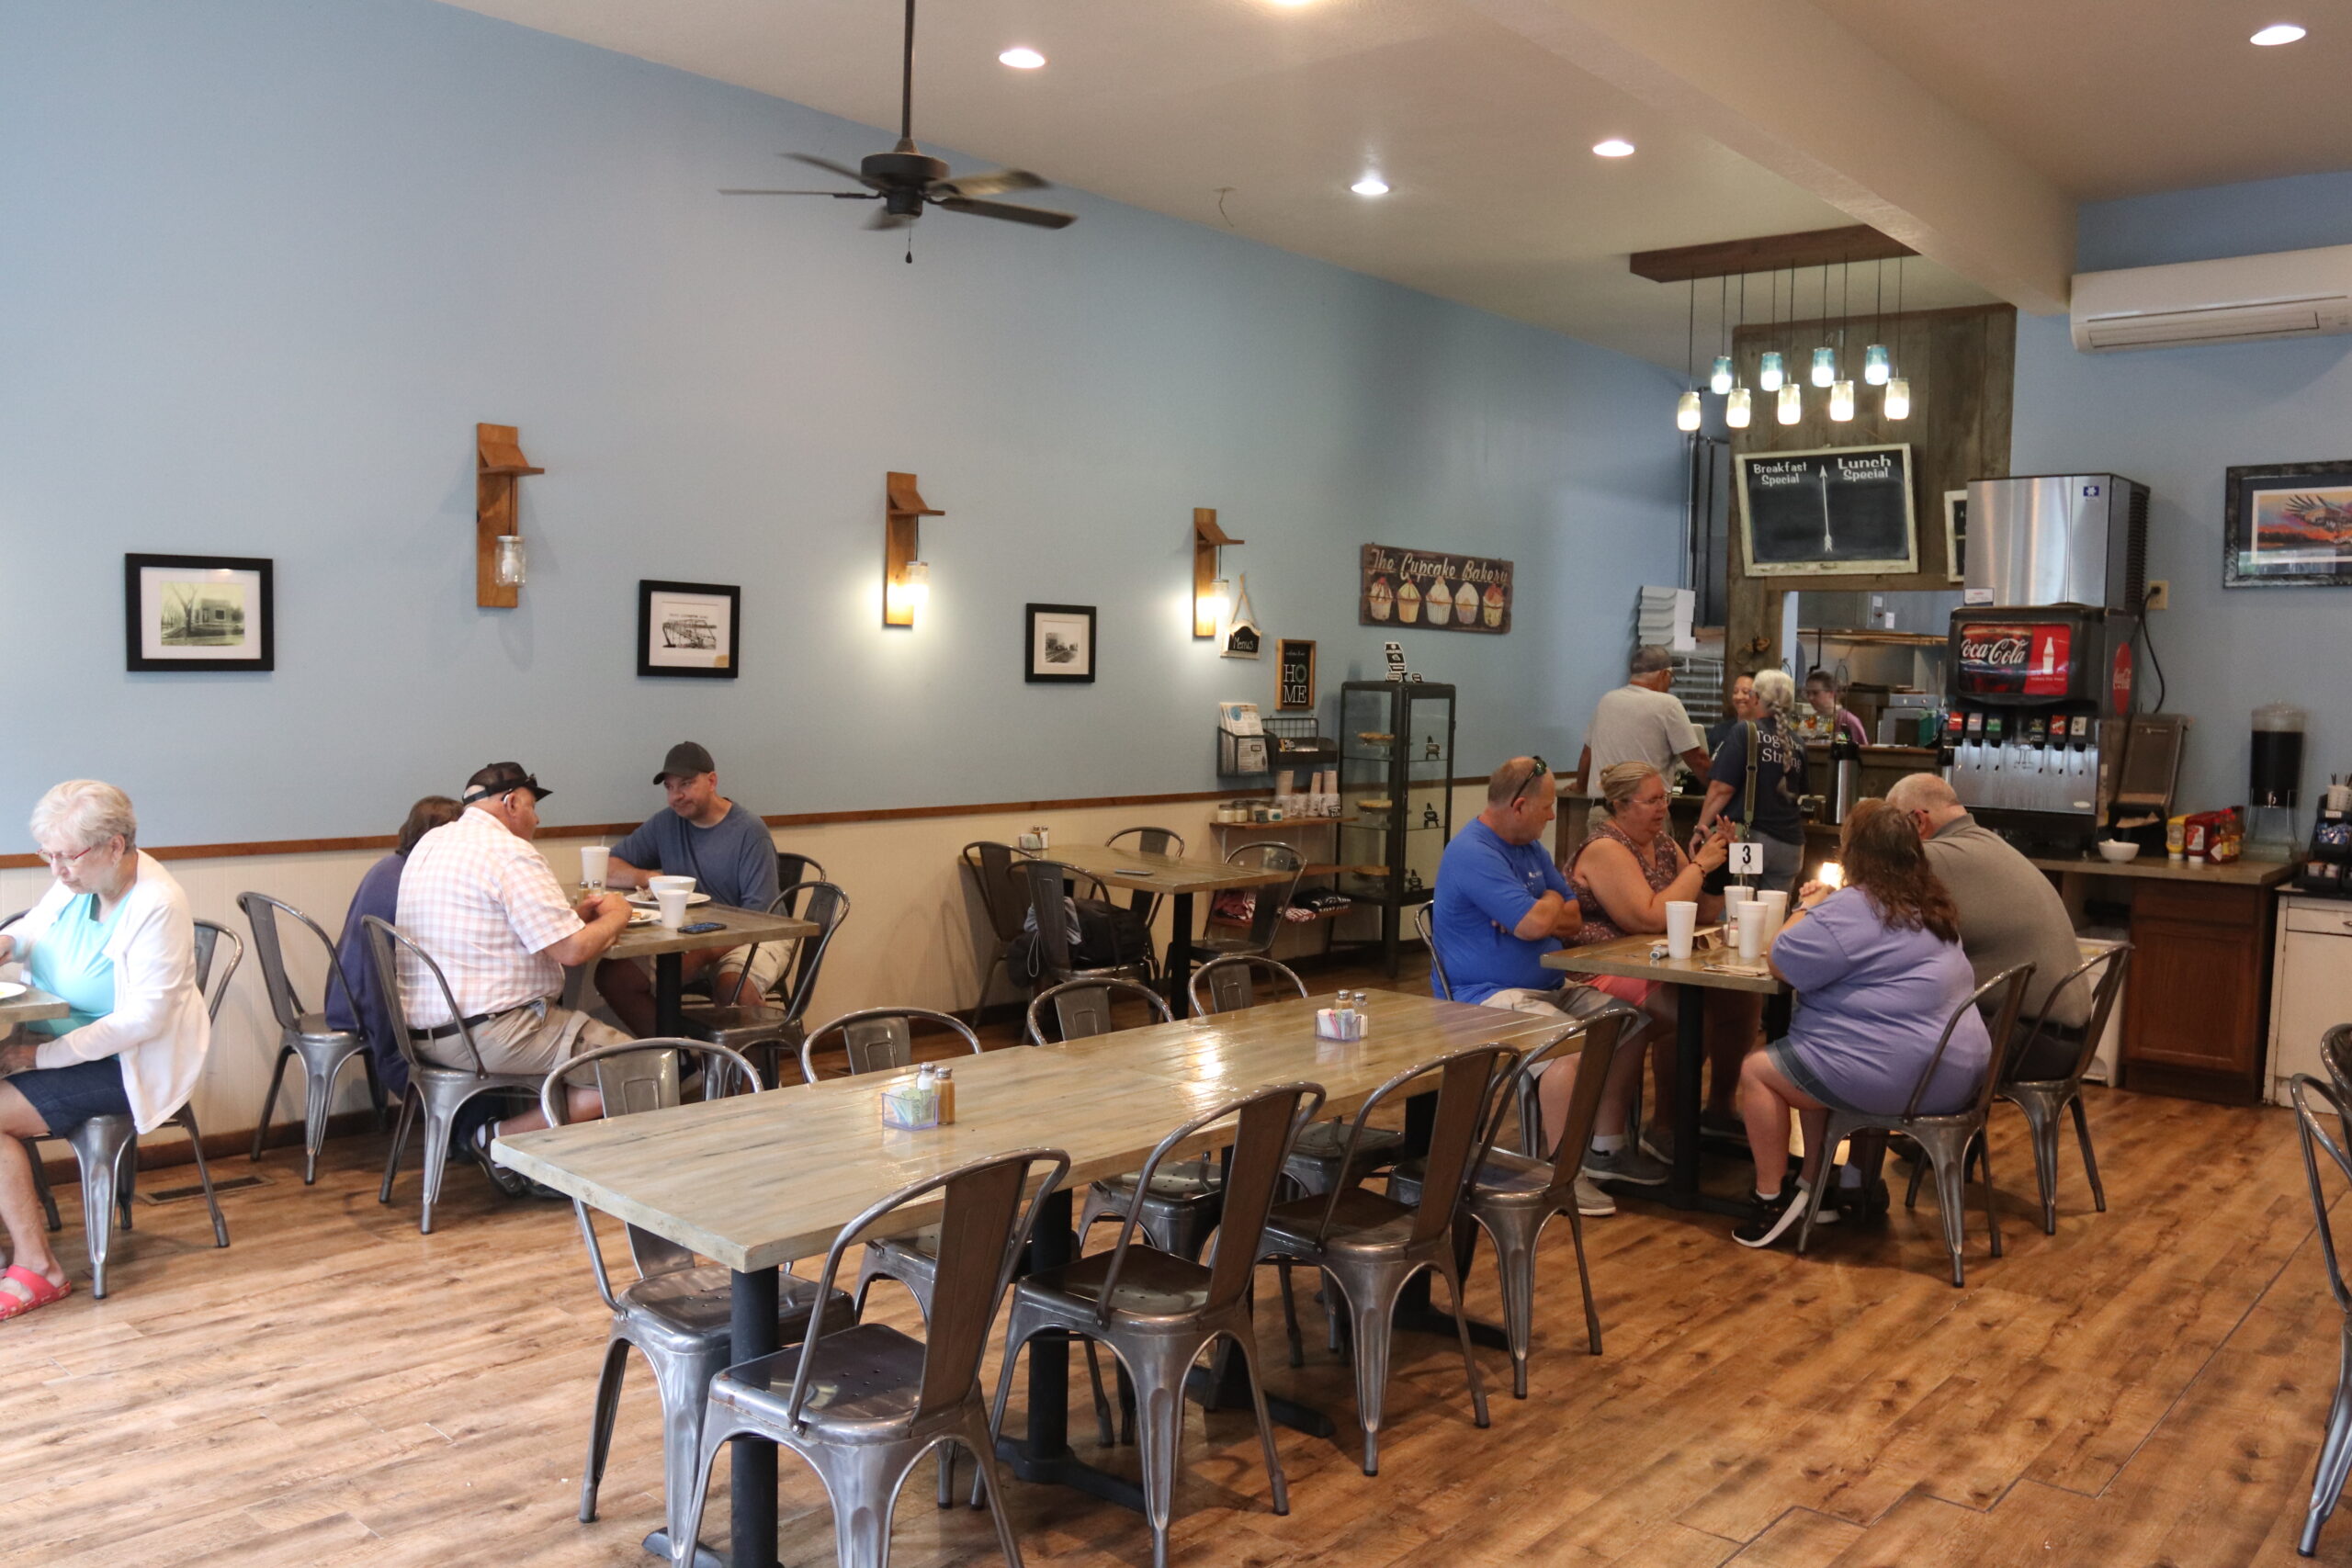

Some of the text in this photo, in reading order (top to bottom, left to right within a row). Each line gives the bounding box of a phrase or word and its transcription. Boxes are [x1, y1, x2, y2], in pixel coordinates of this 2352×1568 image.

[1753, 461, 1807, 474] Breakfast
[1838, 454, 1892, 470] Lunch
[1761, 472, 1800, 487] Special
[1843, 467, 1889, 482] Special
[1368, 547, 1509, 588] The Cupcake Bakery
[1961, 637, 2029, 665] Coca-Cola
[1761, 748, 1802, 773] Strng
[1742, 844, 1751, 864] 3
